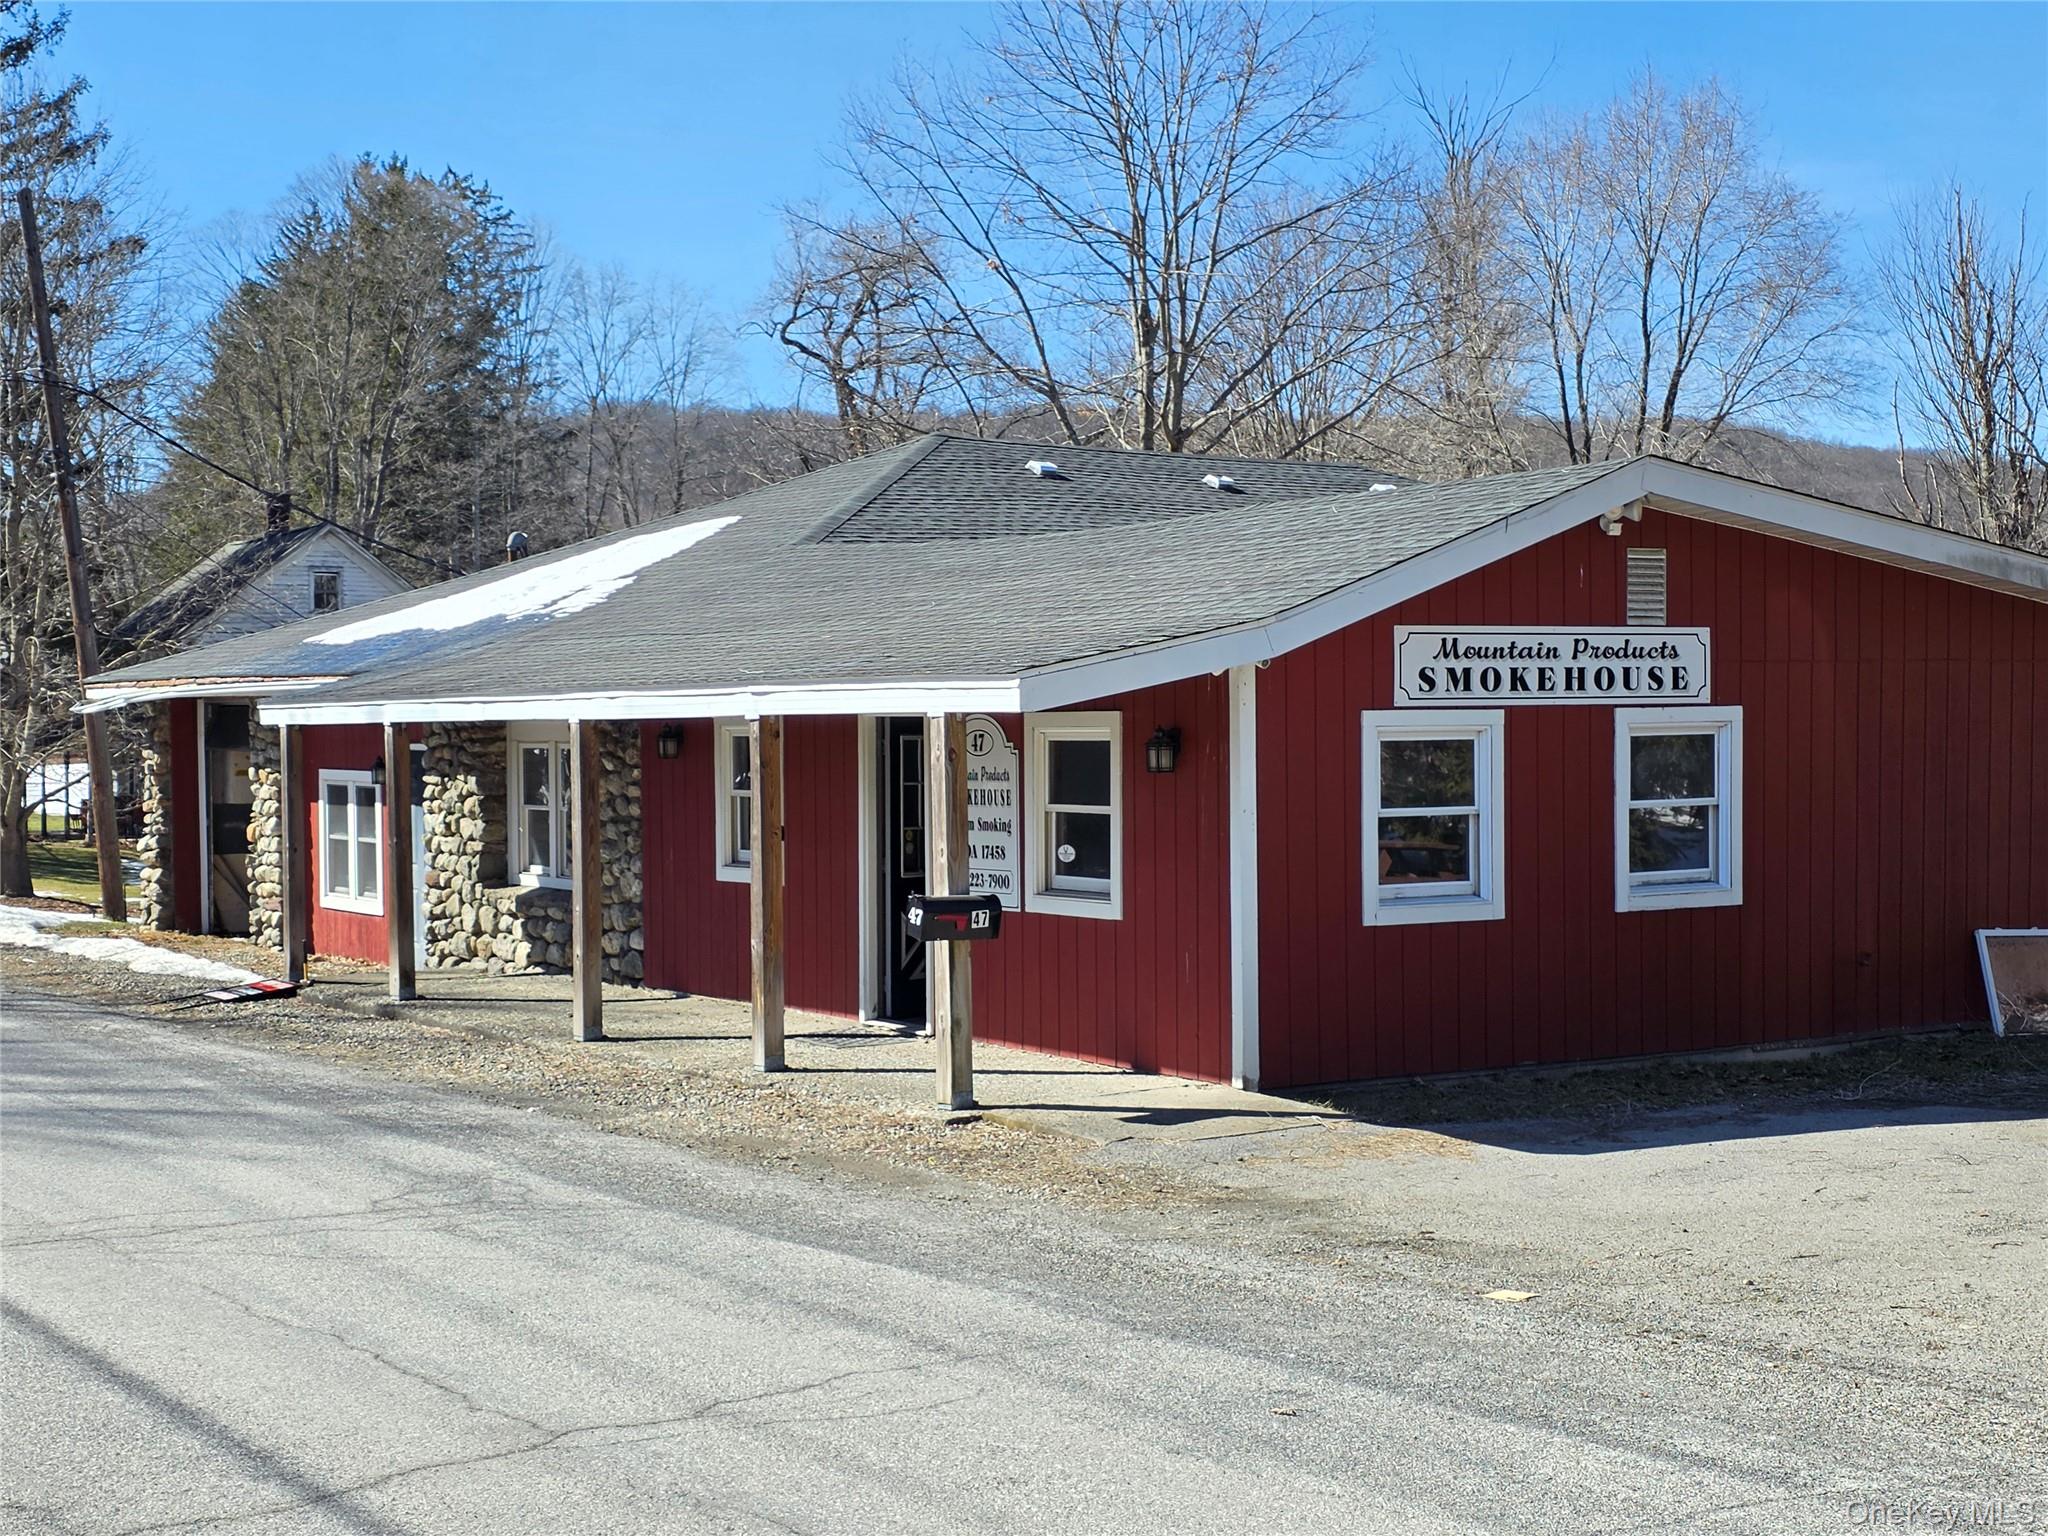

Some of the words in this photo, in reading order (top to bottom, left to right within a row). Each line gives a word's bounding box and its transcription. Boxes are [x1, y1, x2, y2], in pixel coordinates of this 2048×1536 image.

[1433, 637, 1560, 660] Mountain
[1571, 638, 1679, 660] Products
[1418, 666, 1689, 692] SMOKEHOUSE
[971, 733, 984, 752] 47
[981, 766, 1010, 782] Products
[967, 789, 1012, 806] KEHOUSE
[977, 816, 1012, 837] Smoking
[908, 906, 924, 926] 47
[973, 911, 988, 927] 47
